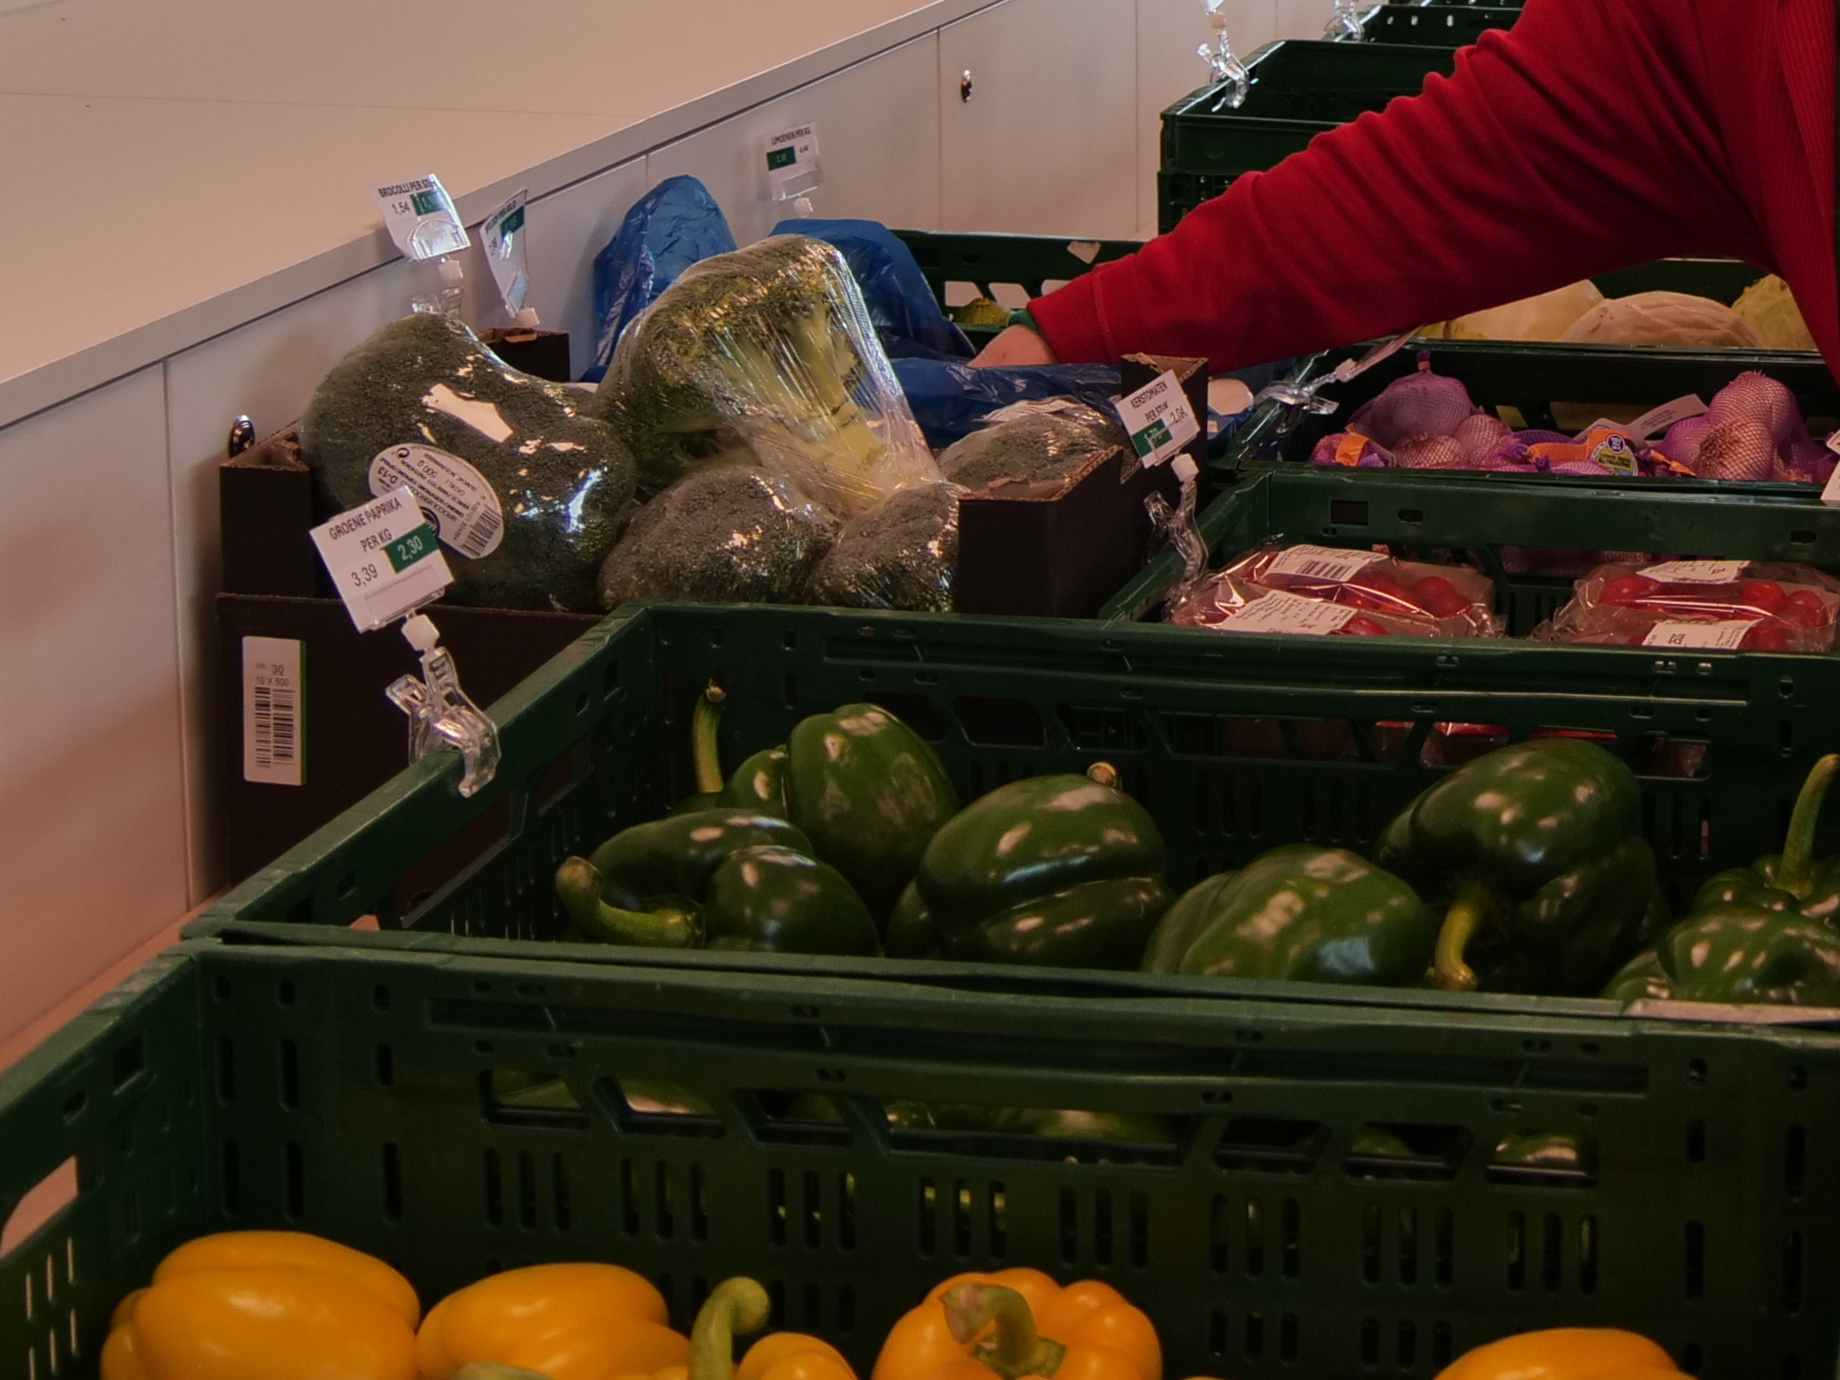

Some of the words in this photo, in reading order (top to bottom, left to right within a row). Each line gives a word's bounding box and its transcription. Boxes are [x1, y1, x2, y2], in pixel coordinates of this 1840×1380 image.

[410, 180, 422, 192] PER
[391, 201, 411, 216] 1,54
[1131, 380, 1168, 409] KERSTOMATEN
[1144, 409, 1156, 423] PER
[376, 465, 399, 485] D-13
[329, 515, 367, 540] GROENE
[366, 496, 403, 525] PAPRIKA
[360, 535, 380, 553] PER
[380, 528, 392, 545] KG
[397, 535, 423, 560] 2,30
[351, 563, 378, 587] 3,39
